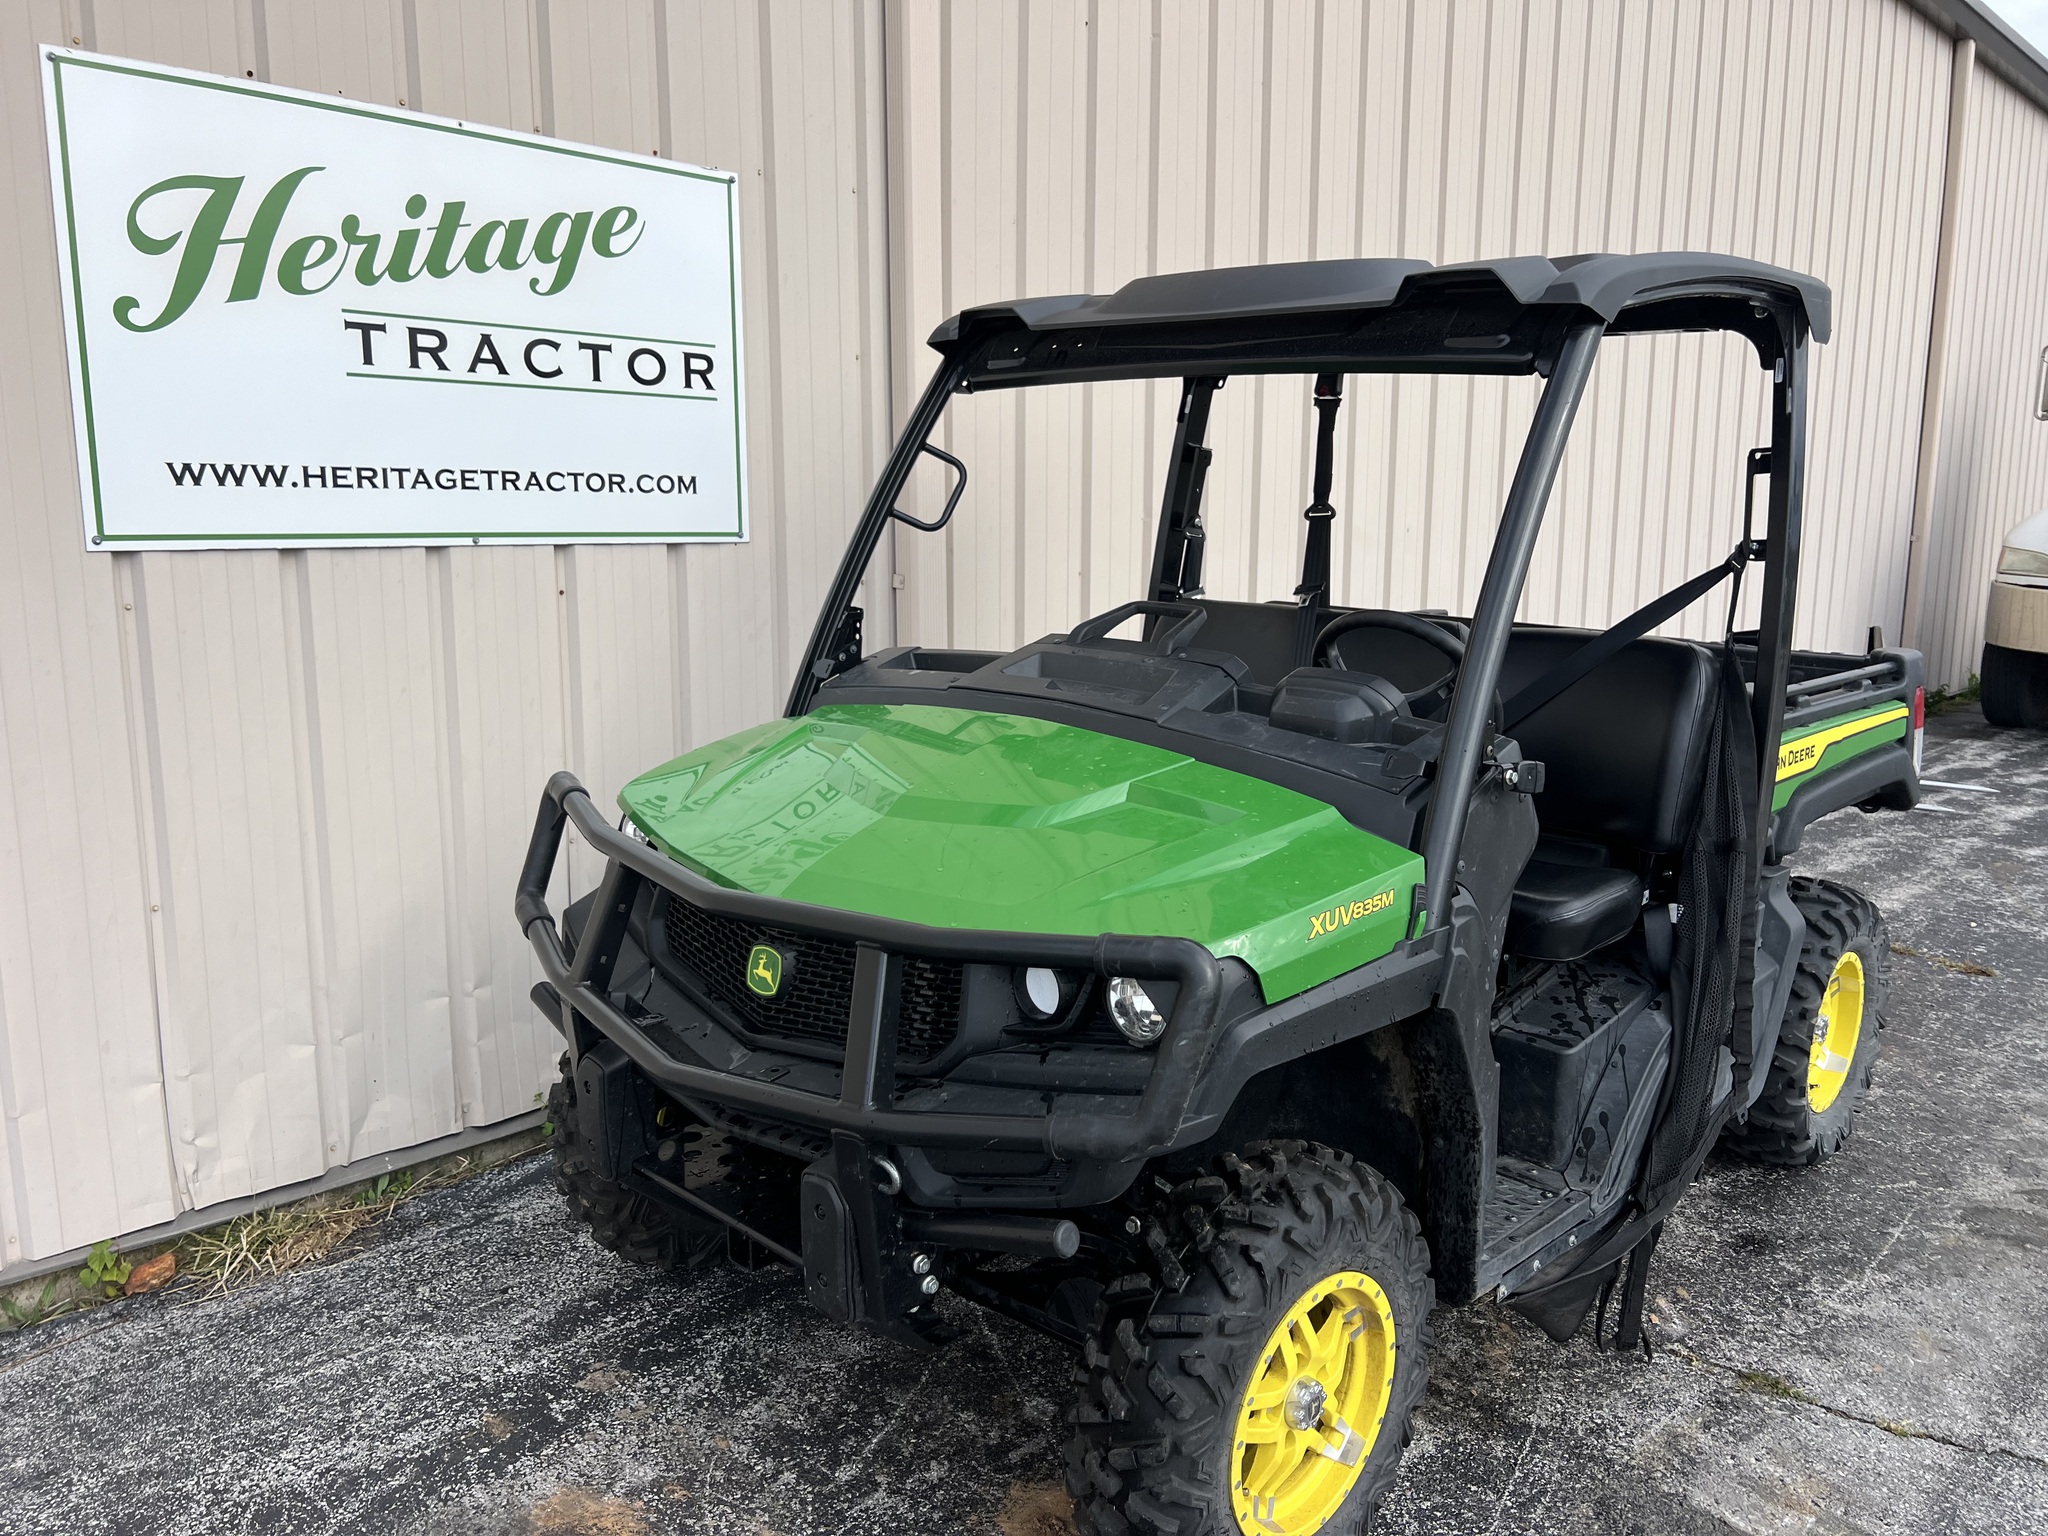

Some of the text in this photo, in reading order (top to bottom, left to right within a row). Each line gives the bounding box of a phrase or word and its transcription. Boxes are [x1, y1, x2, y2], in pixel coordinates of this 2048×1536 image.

[113, 166, 646, 333] Heritage
[344, 318, 717, 392] TRACTOR
[165, 461, 698, 495] WWW.HERITAGETRACTOR.COM
[1788, 744, 1816, 767] DEERE
[1308, 888, 1395, 941] XUV835M
